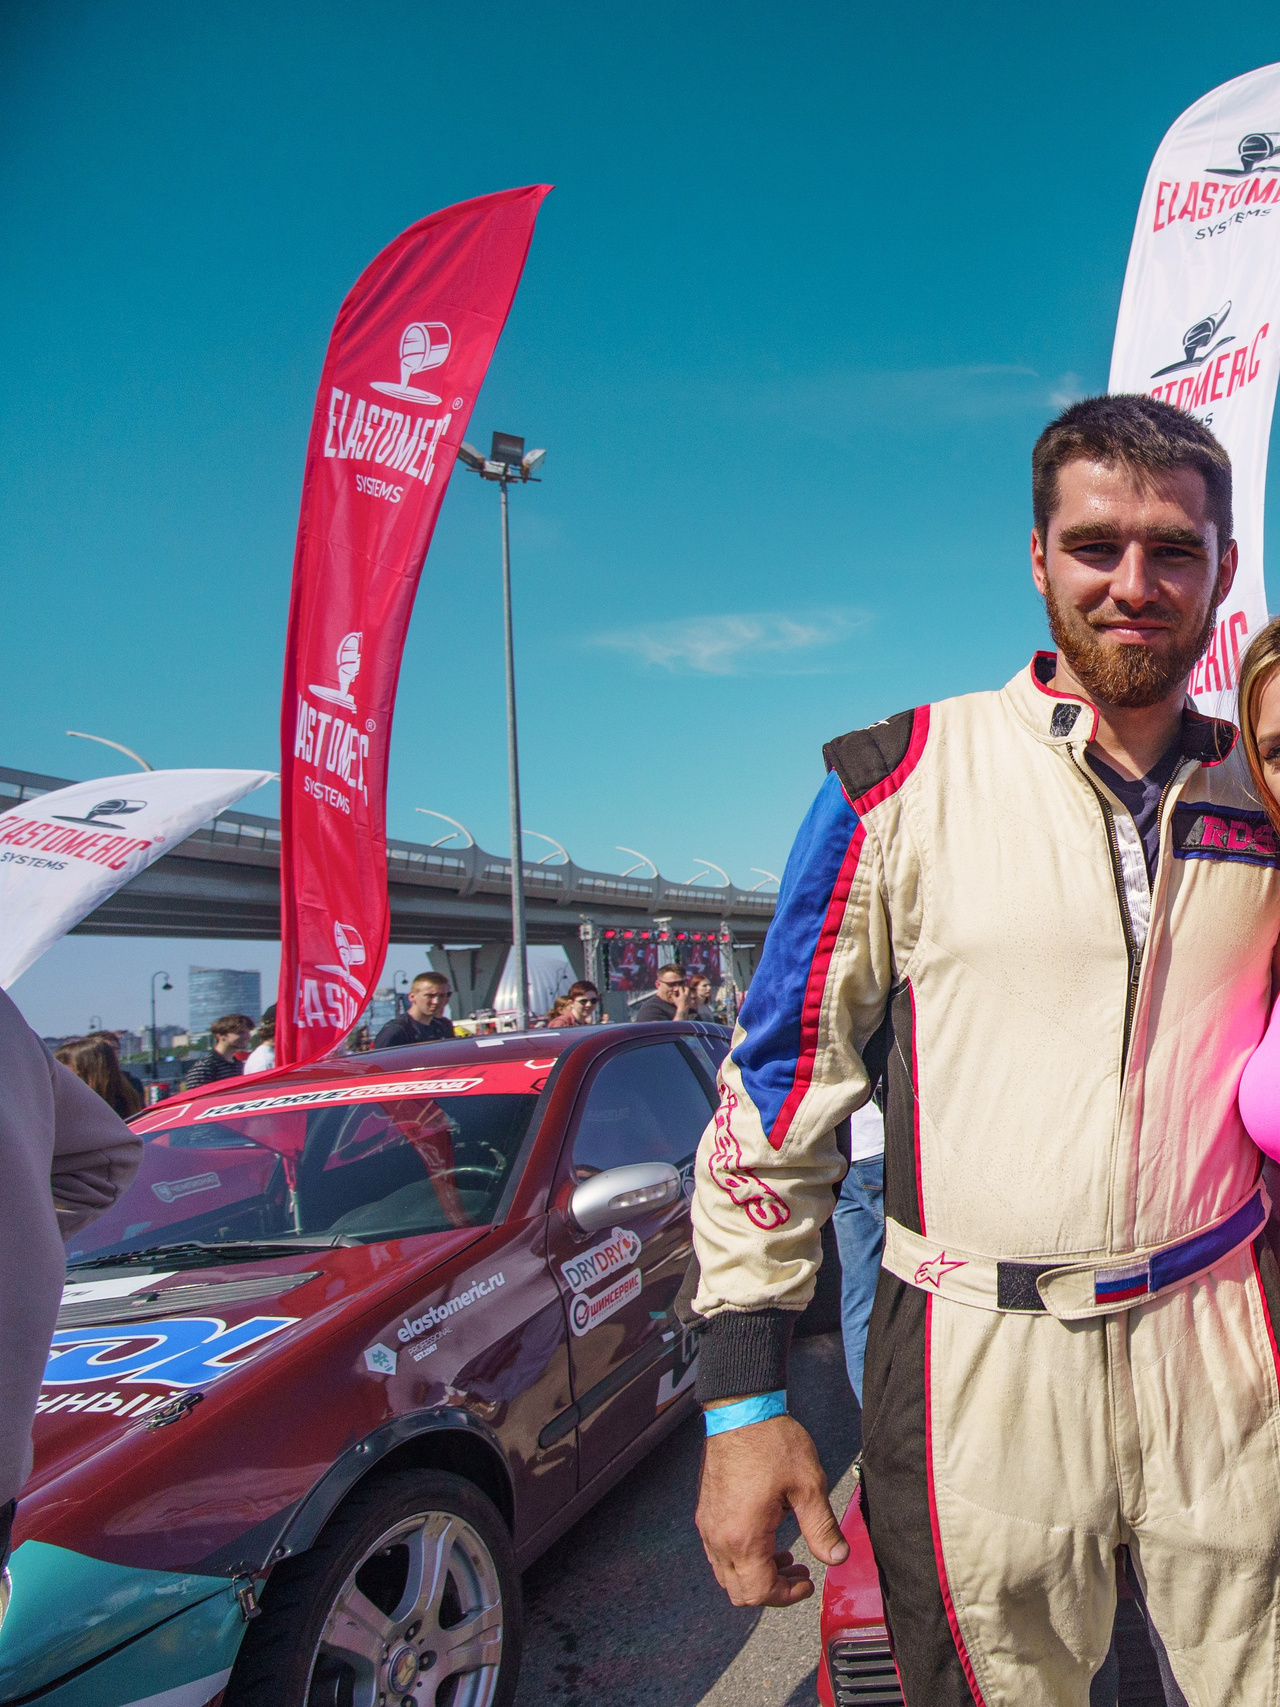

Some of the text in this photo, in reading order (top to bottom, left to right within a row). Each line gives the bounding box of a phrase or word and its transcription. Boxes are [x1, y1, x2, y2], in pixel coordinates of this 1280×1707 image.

[1195, 208, 1272, 240] SYSTEMS
[356, 474, 404, 504] SYSTEMS
[304, 775, 351, 814] SYSTEMS
[1, 852, 69, 871] SYSTEMS
[202, 1080, 467, 1117] YUKA DRIVE GYMKHANA
[565, 1240, 624, 1288] DRYDRY
[397, 1272, 506, 1343] elastomeric.ru
[590, 1274, 639, 1317] ШИНСЕРВИС
